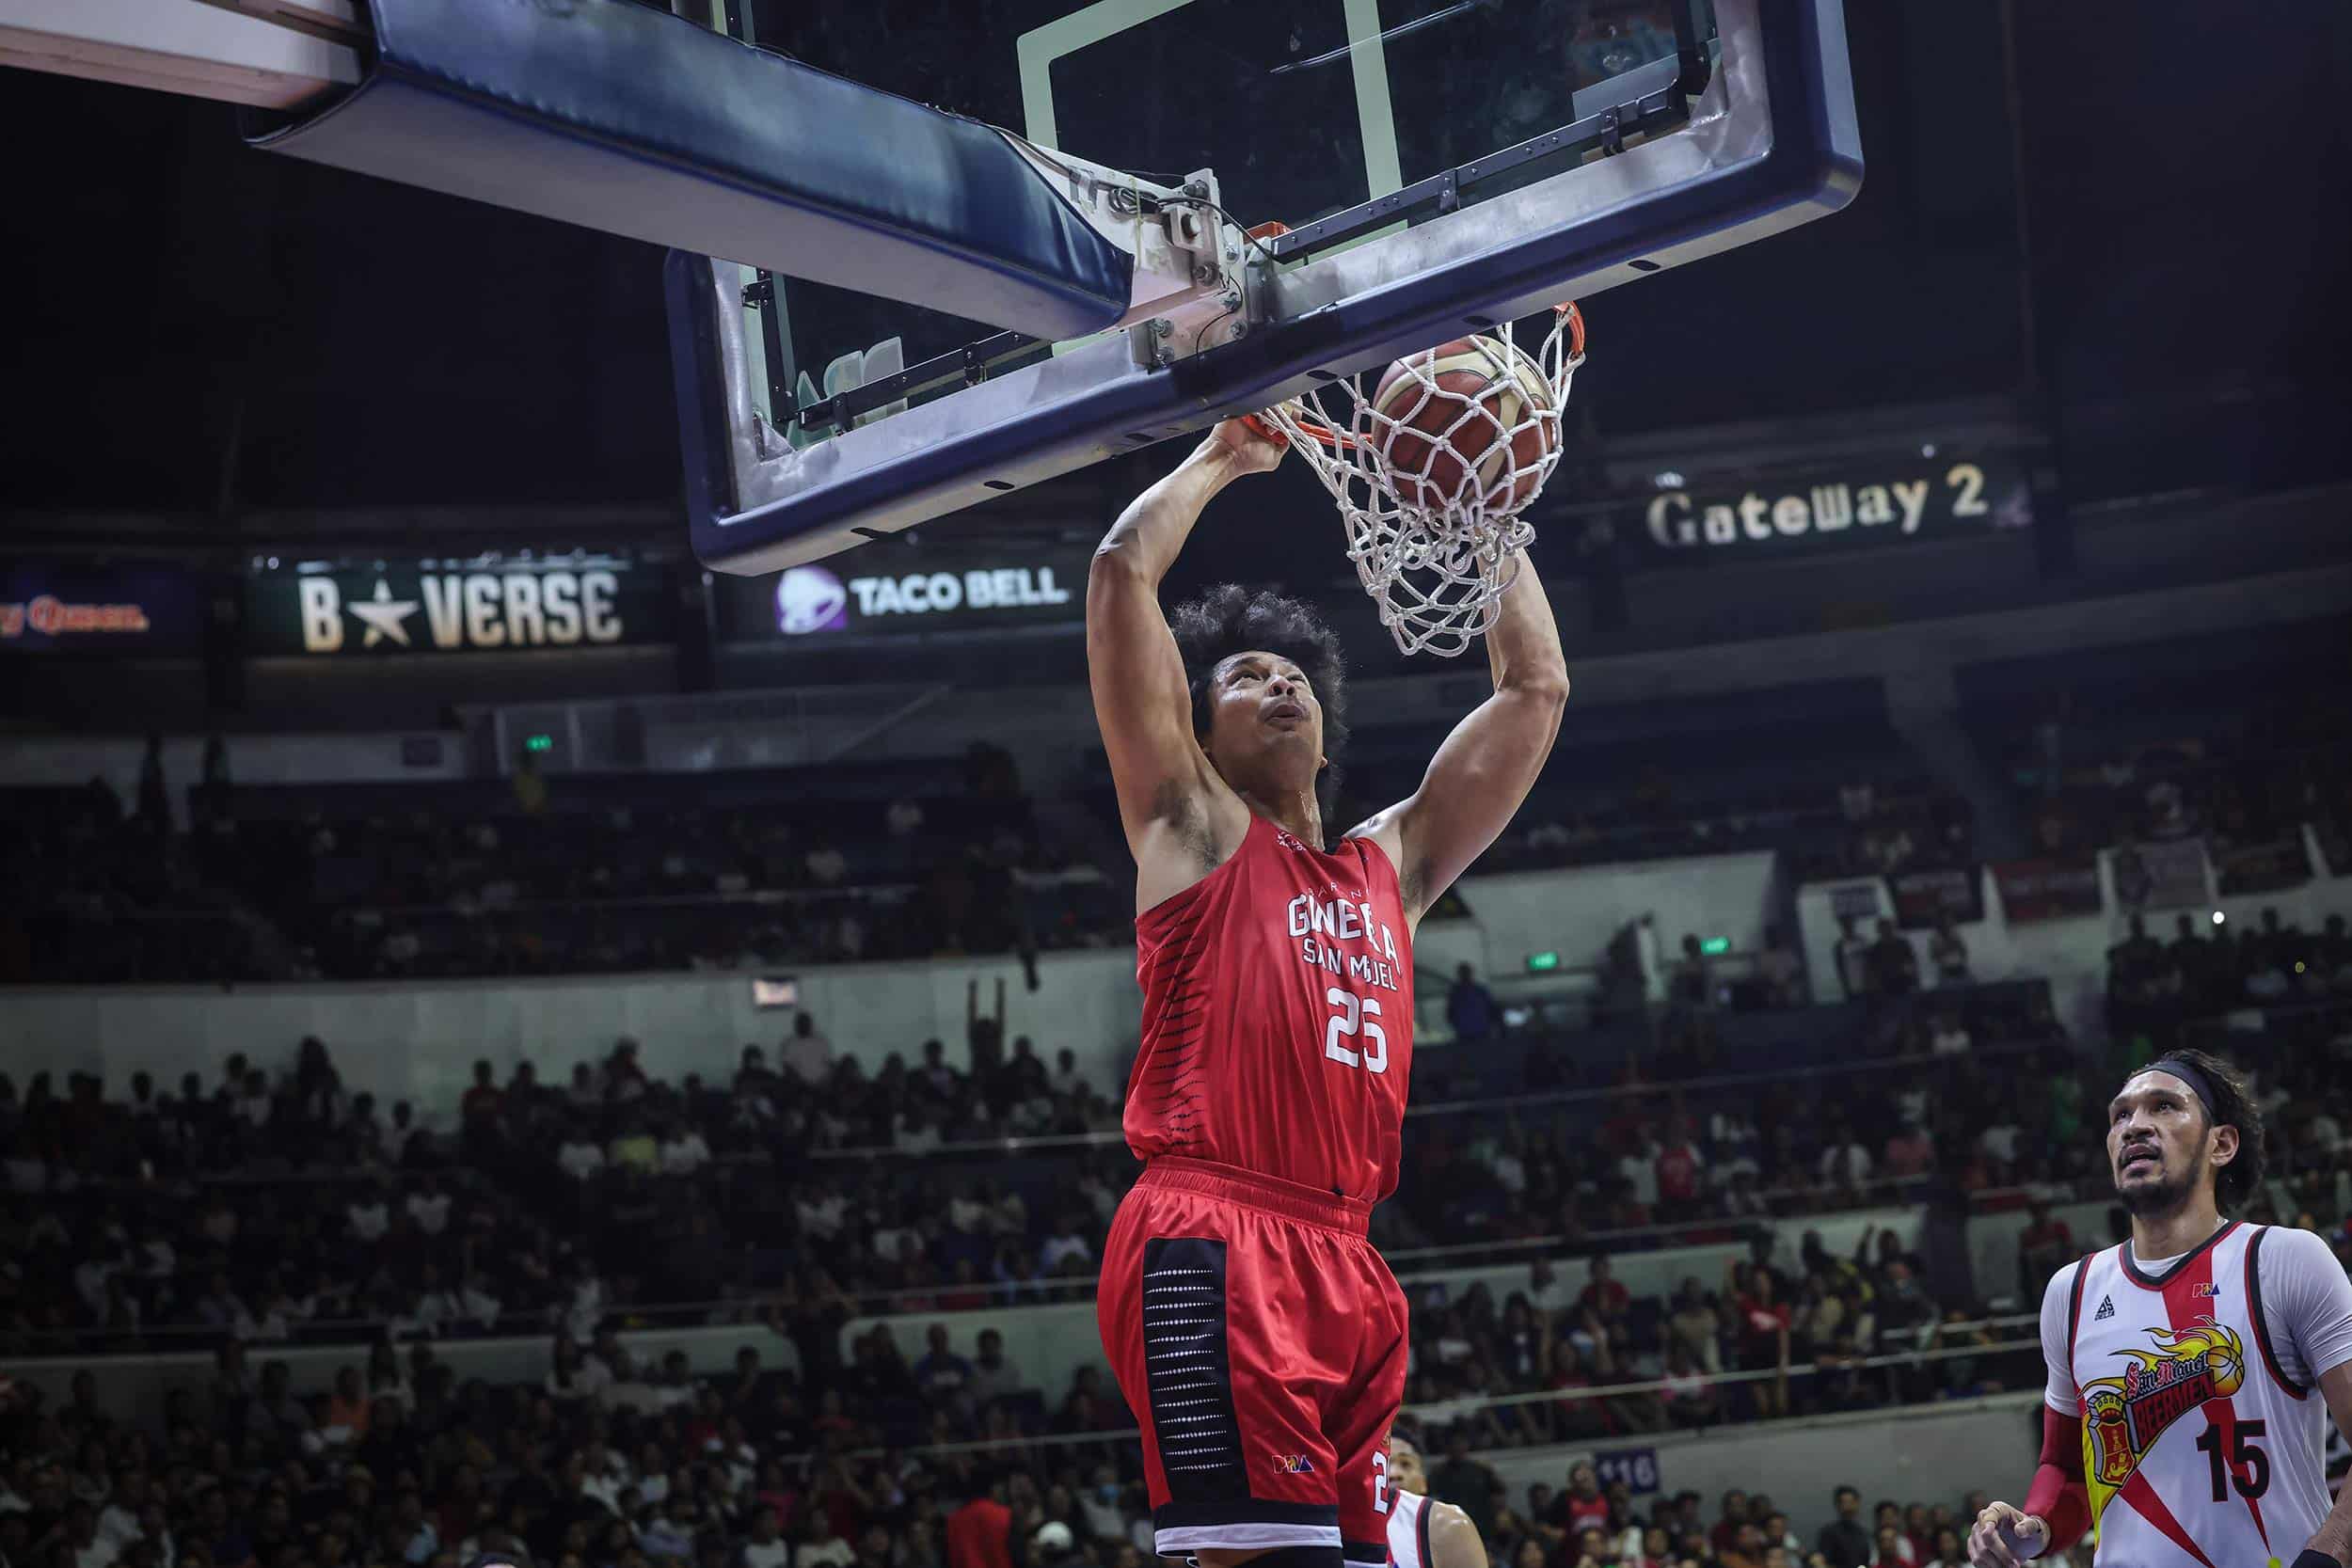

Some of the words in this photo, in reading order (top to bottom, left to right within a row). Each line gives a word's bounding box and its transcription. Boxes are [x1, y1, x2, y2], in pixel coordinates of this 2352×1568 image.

[1946, 462, 1990, 517] 2
[849, 571, 963, 617] TACO
[963, 565, 1071, 610] BELL
[1301, 937, 1343, 975] SAN
[1325, 987, 1388, 1074] 25
[2132, 1370, 2215, 1450] BEERMEN
[2196, 1419, 2270, 1502] 15
